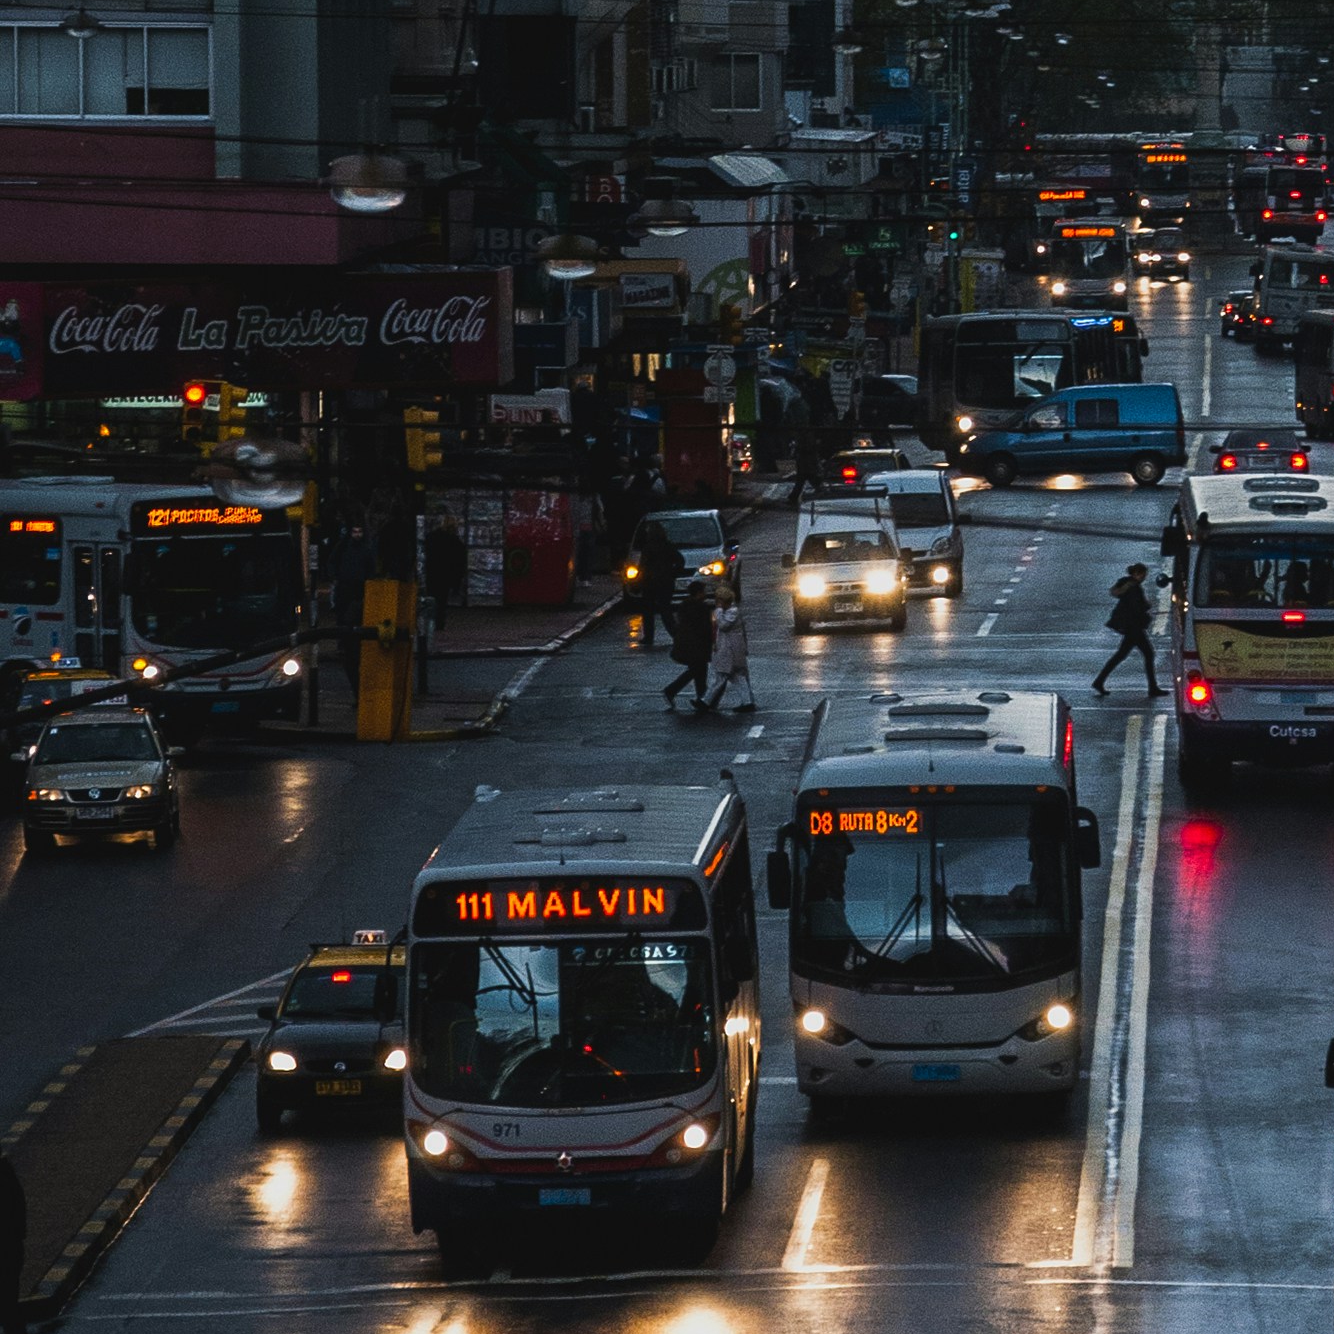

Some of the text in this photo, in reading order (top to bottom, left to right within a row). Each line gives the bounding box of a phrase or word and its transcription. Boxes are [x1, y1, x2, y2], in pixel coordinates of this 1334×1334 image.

[178, 307, 228, 350] La
[235, 305, 367, 349] Pasiva
[148, 509, 171, 527] 121
[1269, 724, 1317, 738] Cutcsa
[810, 811, 834, 836] D8
[839, 811, 874, 835] RUTA
[455, 886, 667, 921] 111 MALVIN
[356, 933, 383, 945] TAXI
[492, 1122, 521, 1138] 971
